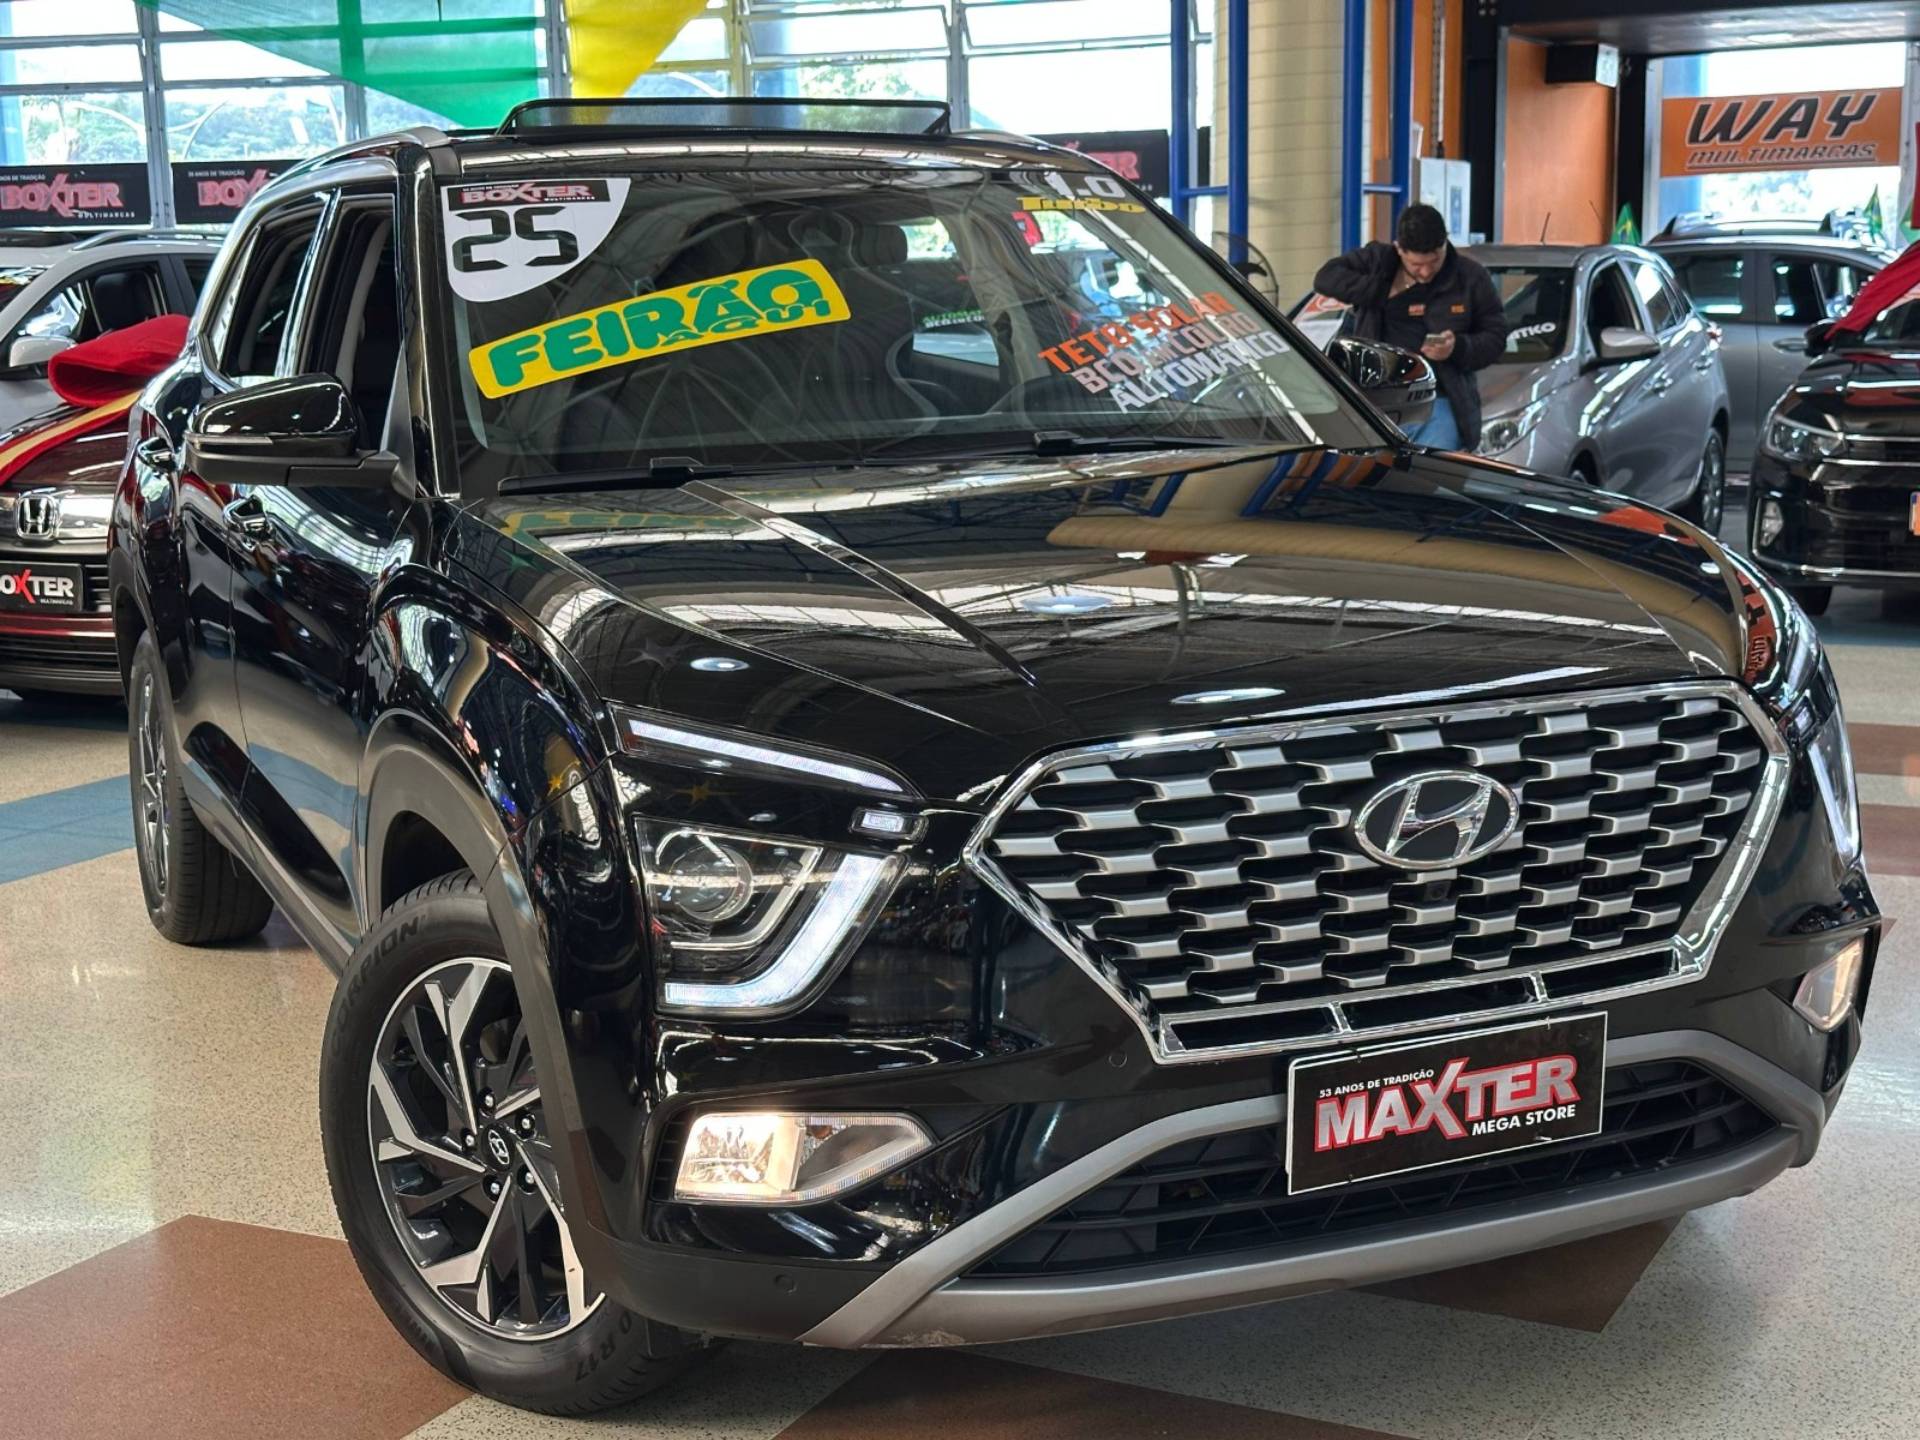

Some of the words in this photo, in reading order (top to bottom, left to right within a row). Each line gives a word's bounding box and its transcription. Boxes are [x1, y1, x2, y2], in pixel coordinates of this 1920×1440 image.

[1687, 93, 1880, 146] WAY
[1688, 144, 1876, 165] MULTIMARCAS
[1, 173, 123, 217] BOXTER
[461, 182, 592, 204] BOXTER
[1044, 171, 1125, 199] 1.0
[452, 206, 579, 273] 25
[488, 269, 824, 388] FEIRÃO
[660, 299, 831, 346] AQUI
[1038, 322, 1134, 374] TETO
[1129, 291, 1237, 337] SOLAR
[1071, 351, 1145, 394] BCO
[1169, 311, 1262, 355] COURO
[1315, 1056, 1581, 1152] MAXTER
[1319, 1088, 1332, 1098] 53
[1334, 1083, 1365, 1096] ANOS
[1367, 1079, 1381, 1089] DE
[1384, 1069, 1435, 1085] TRADIÇÃO
[1472, 1115, 1521, 1136] MEGA
[1526, 1105, 1577, 1128] STORE
